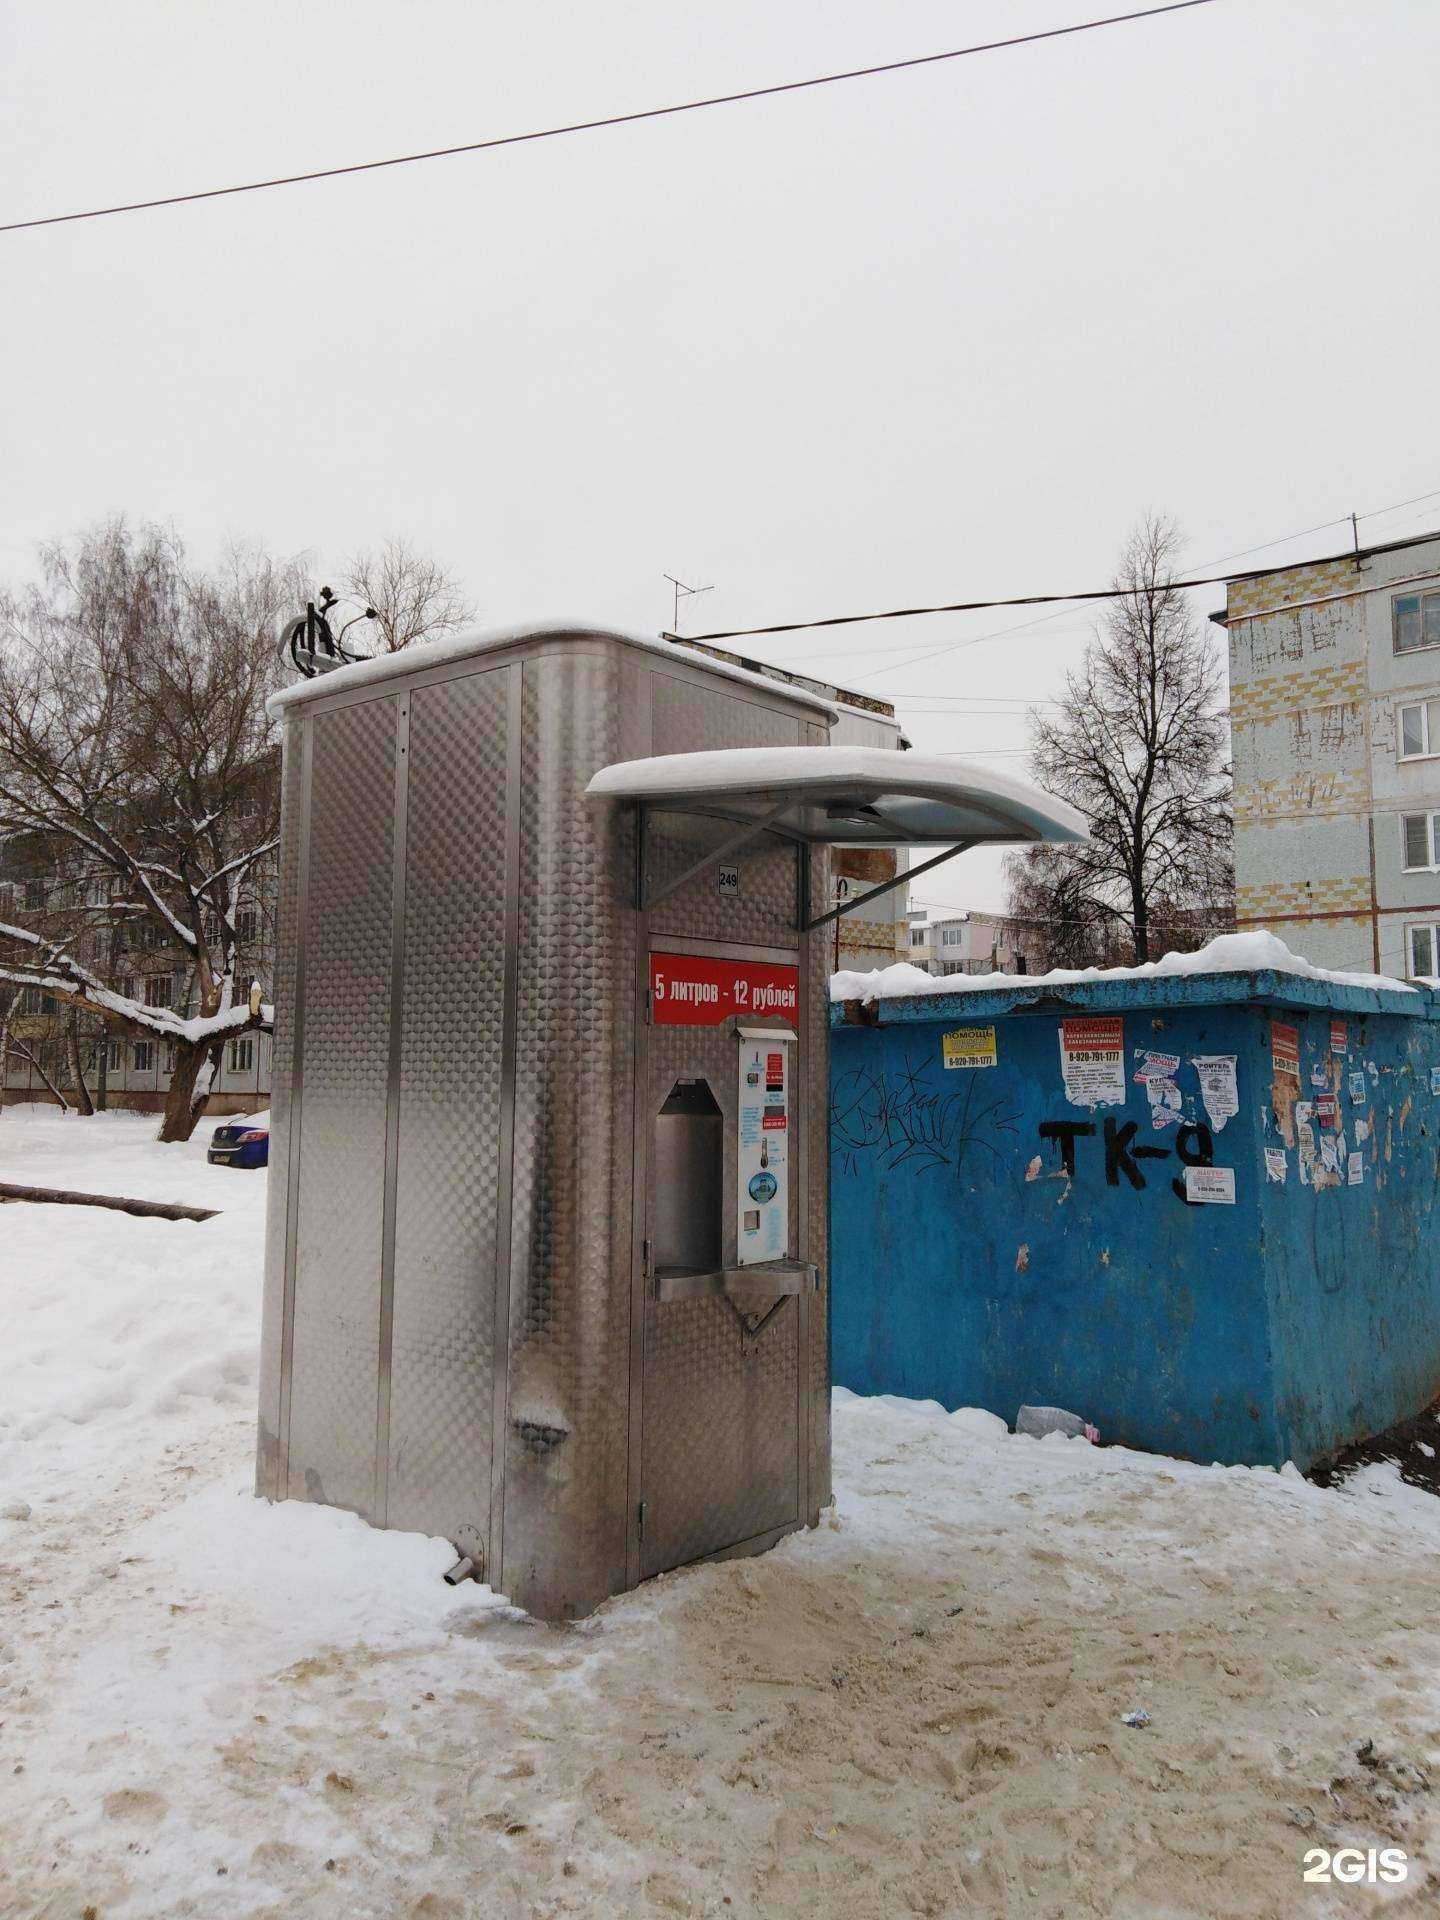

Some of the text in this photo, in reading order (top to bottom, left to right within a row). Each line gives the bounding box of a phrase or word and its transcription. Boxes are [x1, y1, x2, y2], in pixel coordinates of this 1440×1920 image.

[719, 872, 737, 887] 249
[655, 973, 665, 1000] 5
[669, 980, 719, 1007] литров
[733, 980, 749, 1005] 12
[752, 982, 796, 1010] рублей
[1065, 1025, 1120, 1033] ПОМОЩЬ
[944, 1030, 993, 1041] ПОМОЩЬ
[1069, 1052, 1119, 1061] 8-920-791-1777
